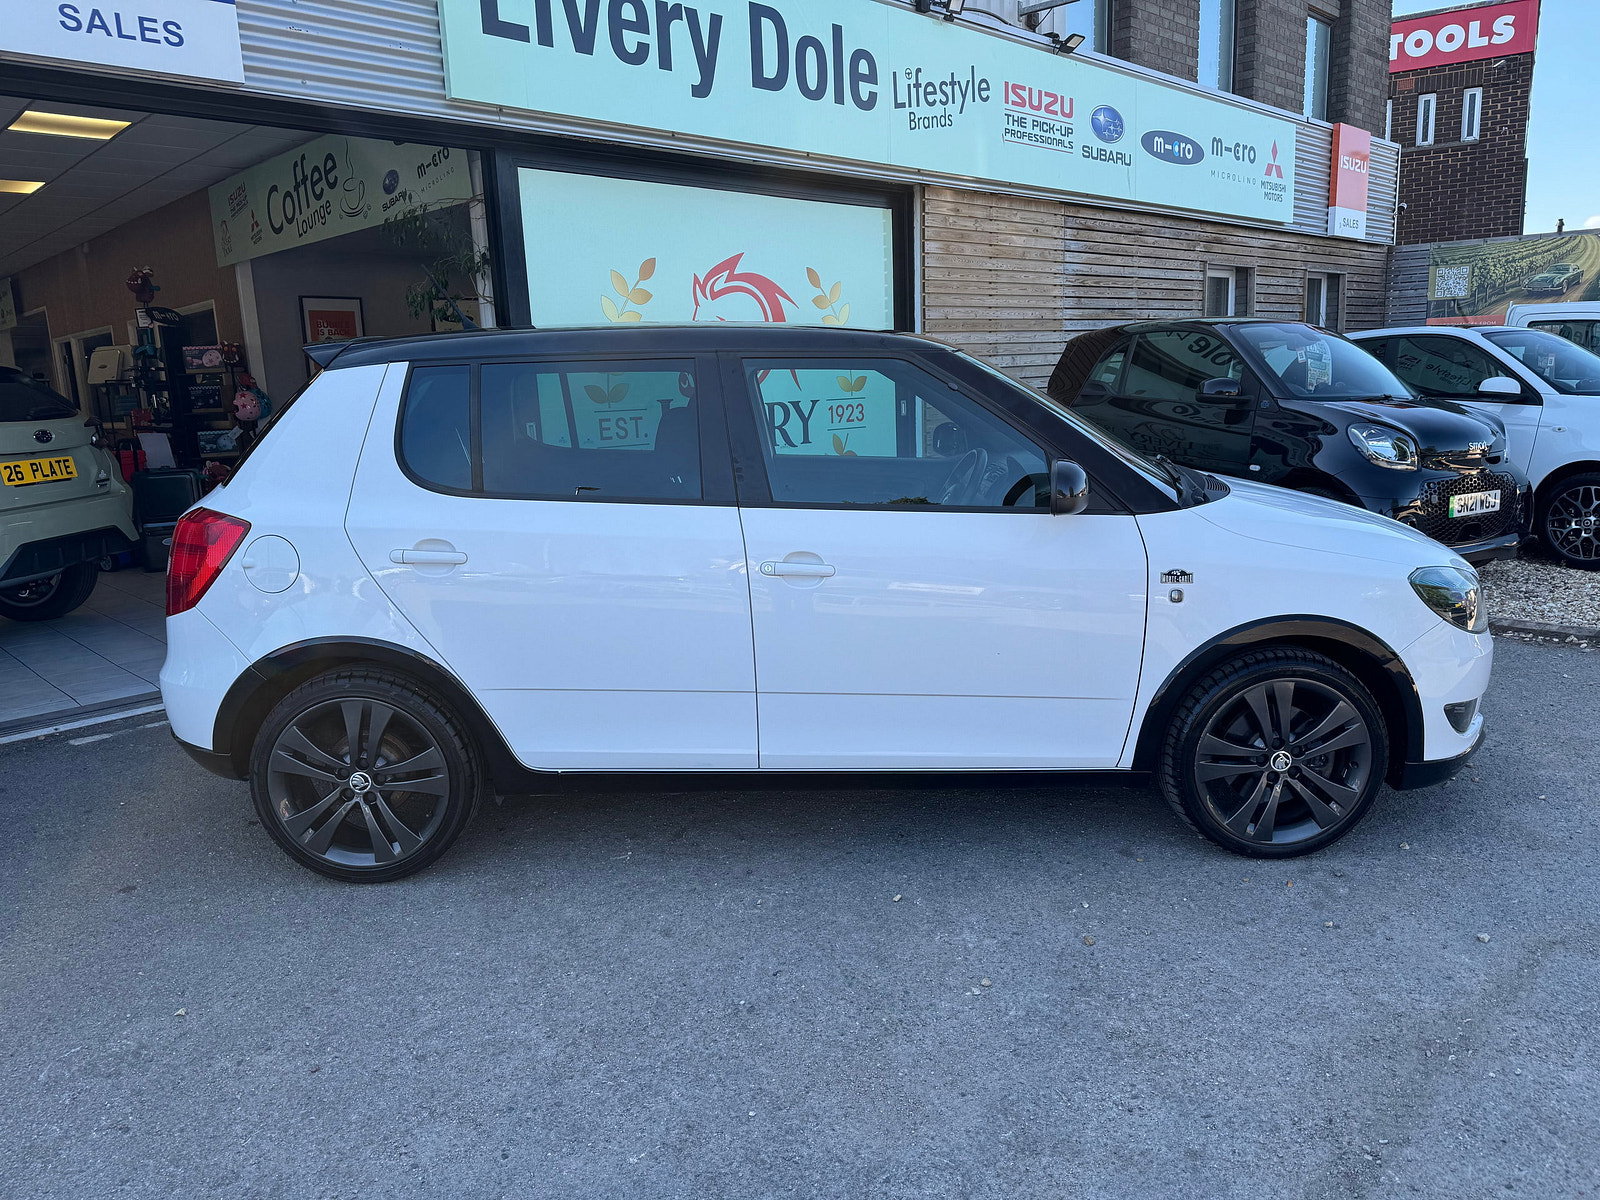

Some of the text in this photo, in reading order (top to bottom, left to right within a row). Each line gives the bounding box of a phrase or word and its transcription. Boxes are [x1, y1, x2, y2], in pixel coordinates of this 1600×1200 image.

[58, 4, 185, 47] SALES
[748, 2, 878, 111] Dole
[892, 65, 990, 114] Lifestyle
[1004, 81, 1073, 119] ISUZU
[908, 108, 953, 131] Brands
[1004, 113, 1073, 138] THE PICK-UP
[1004, 128, 1073, 149] PROFESSIONALS
[1081, 145, 1132, 167] SUBARU
[1340, 154, 1367, 173] ISUZU
[1210, 169, 1257, 186] MICROLINO
[1260, 180, 1286, 193] MITSUBISHI
[267, 152, 338, 235] Coffee
[1264, 192, 1283, 203] MOTORS
[295, 199, 332, 238] Lounge
[1342, 217, 1359, 230] SALES
[827, 403, 865, 424] 1923
[598, 416, 648, 440] EST.
[3, 459, 73, 483] 26 PLATE
